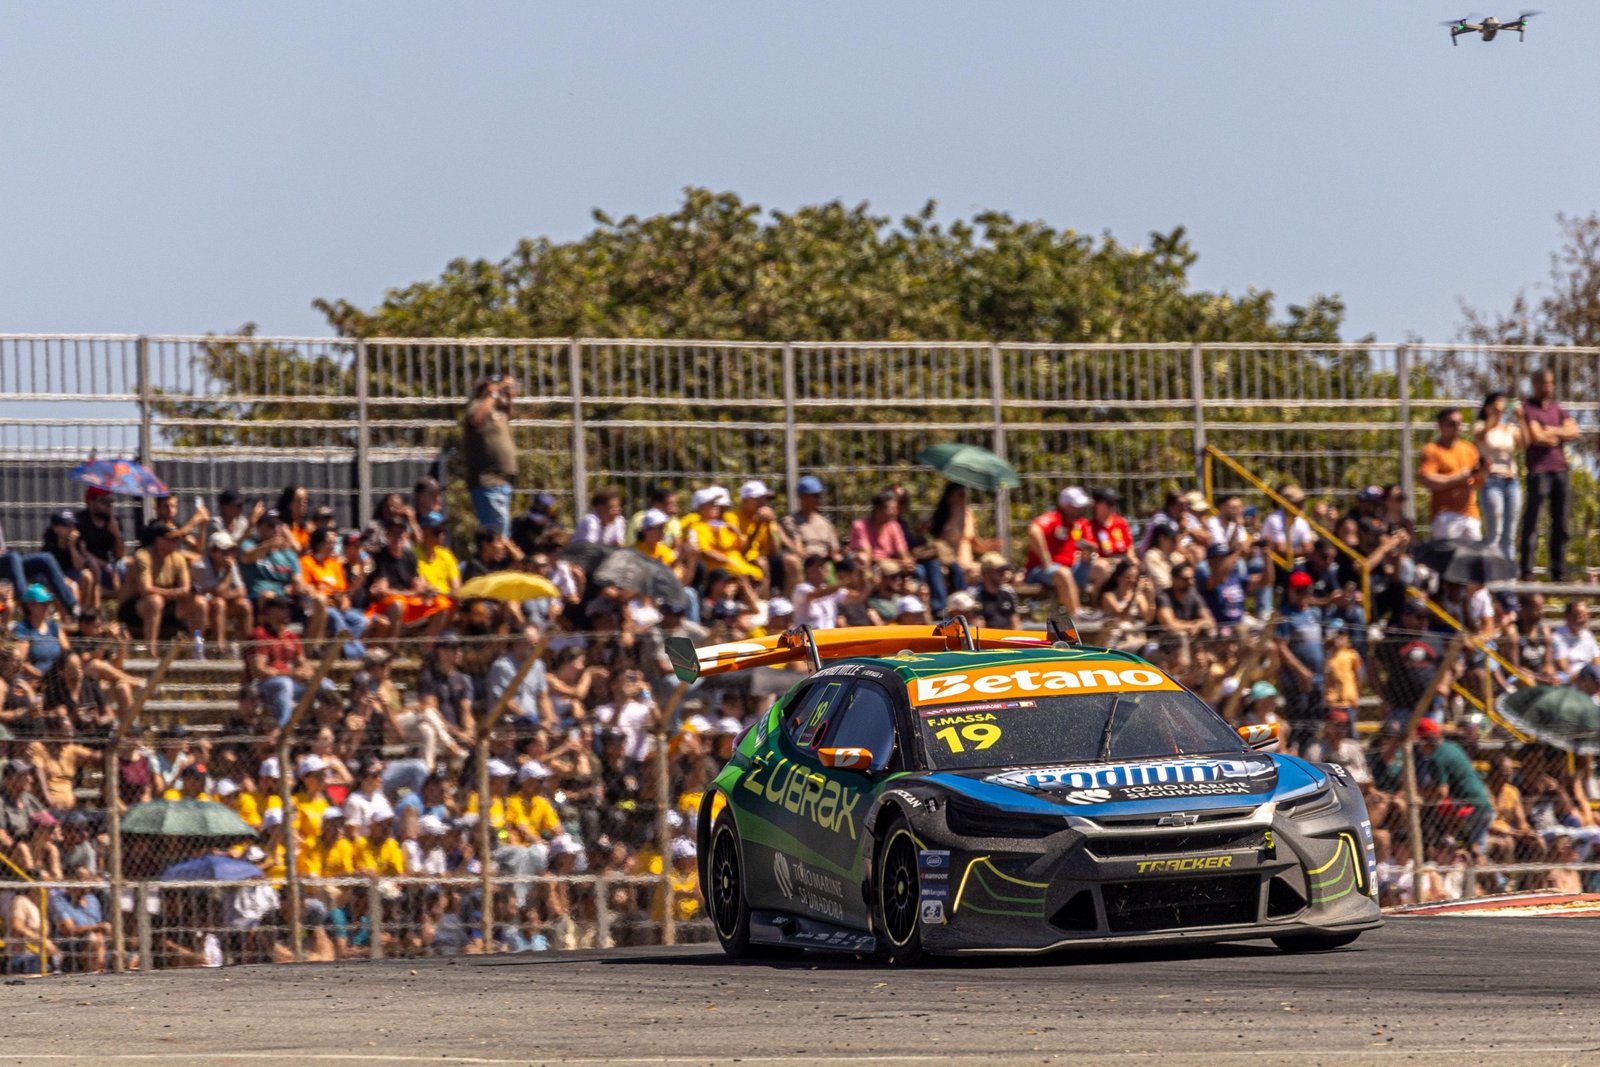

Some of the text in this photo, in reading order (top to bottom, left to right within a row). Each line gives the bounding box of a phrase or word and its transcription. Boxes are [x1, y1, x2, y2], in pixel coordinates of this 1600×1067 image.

[917, 668, 1164, 702] Betano
[927, 713, 998, 727] F.MASSA
[935, 723, 1002, 754] 19
[1120, 780, 1251, 794] TOKIO MARINE
[1128, 788, 1251, 799] SEGURADORA
[1136, 855, 1233, 873] TRACKER
